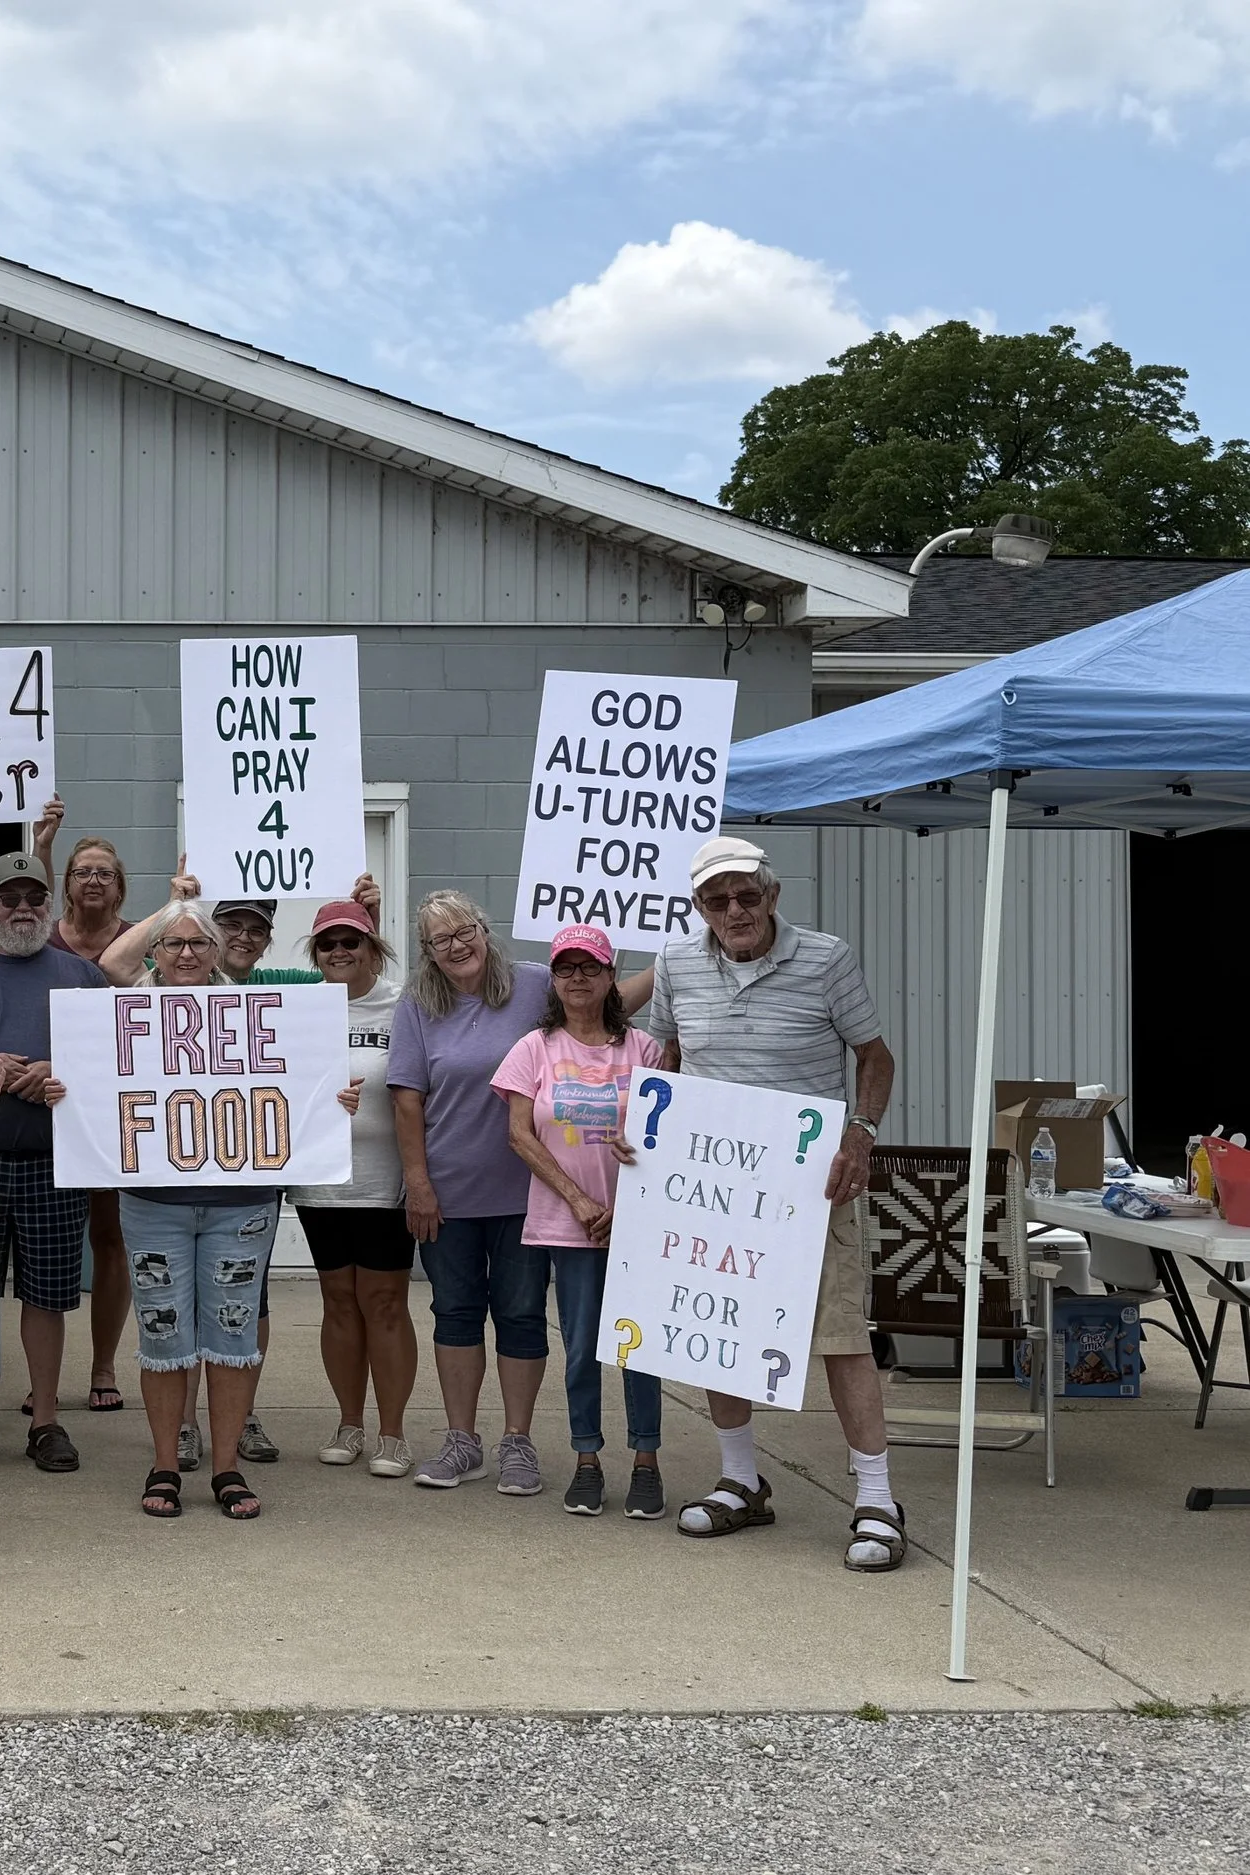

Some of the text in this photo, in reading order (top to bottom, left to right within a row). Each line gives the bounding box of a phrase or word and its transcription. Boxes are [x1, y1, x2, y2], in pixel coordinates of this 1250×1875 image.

[232, 644, 302, 688] HOW
[9, 650, 50, 742] 4
[216, 696, 317, 742] CAN I
[591, 689, 682, 731] GOD
[232, 747, 309, 795] PRAY
[545, 735, 717, 785] ALLOWS
[257, 800, 289, 840] 4
[534, 783, 717, 833] U-TURNS
[234, 846, 314, 893] YOU?
[576, 837, 660, 880] FOR
[531, 883, 693, 935] PRAYER
[114, 992, 287, 1076] FREE
[118, 1086, 291, 1173] FOOD
[687, 1132, 768, 1172] HOW
[664, 1173, 767, 1220] CAN I
[660, 1230, 766, 1279] PRAY
[669, 1284, 739, 1327] FOR
[662, 1323, 740, 1369] YOU
